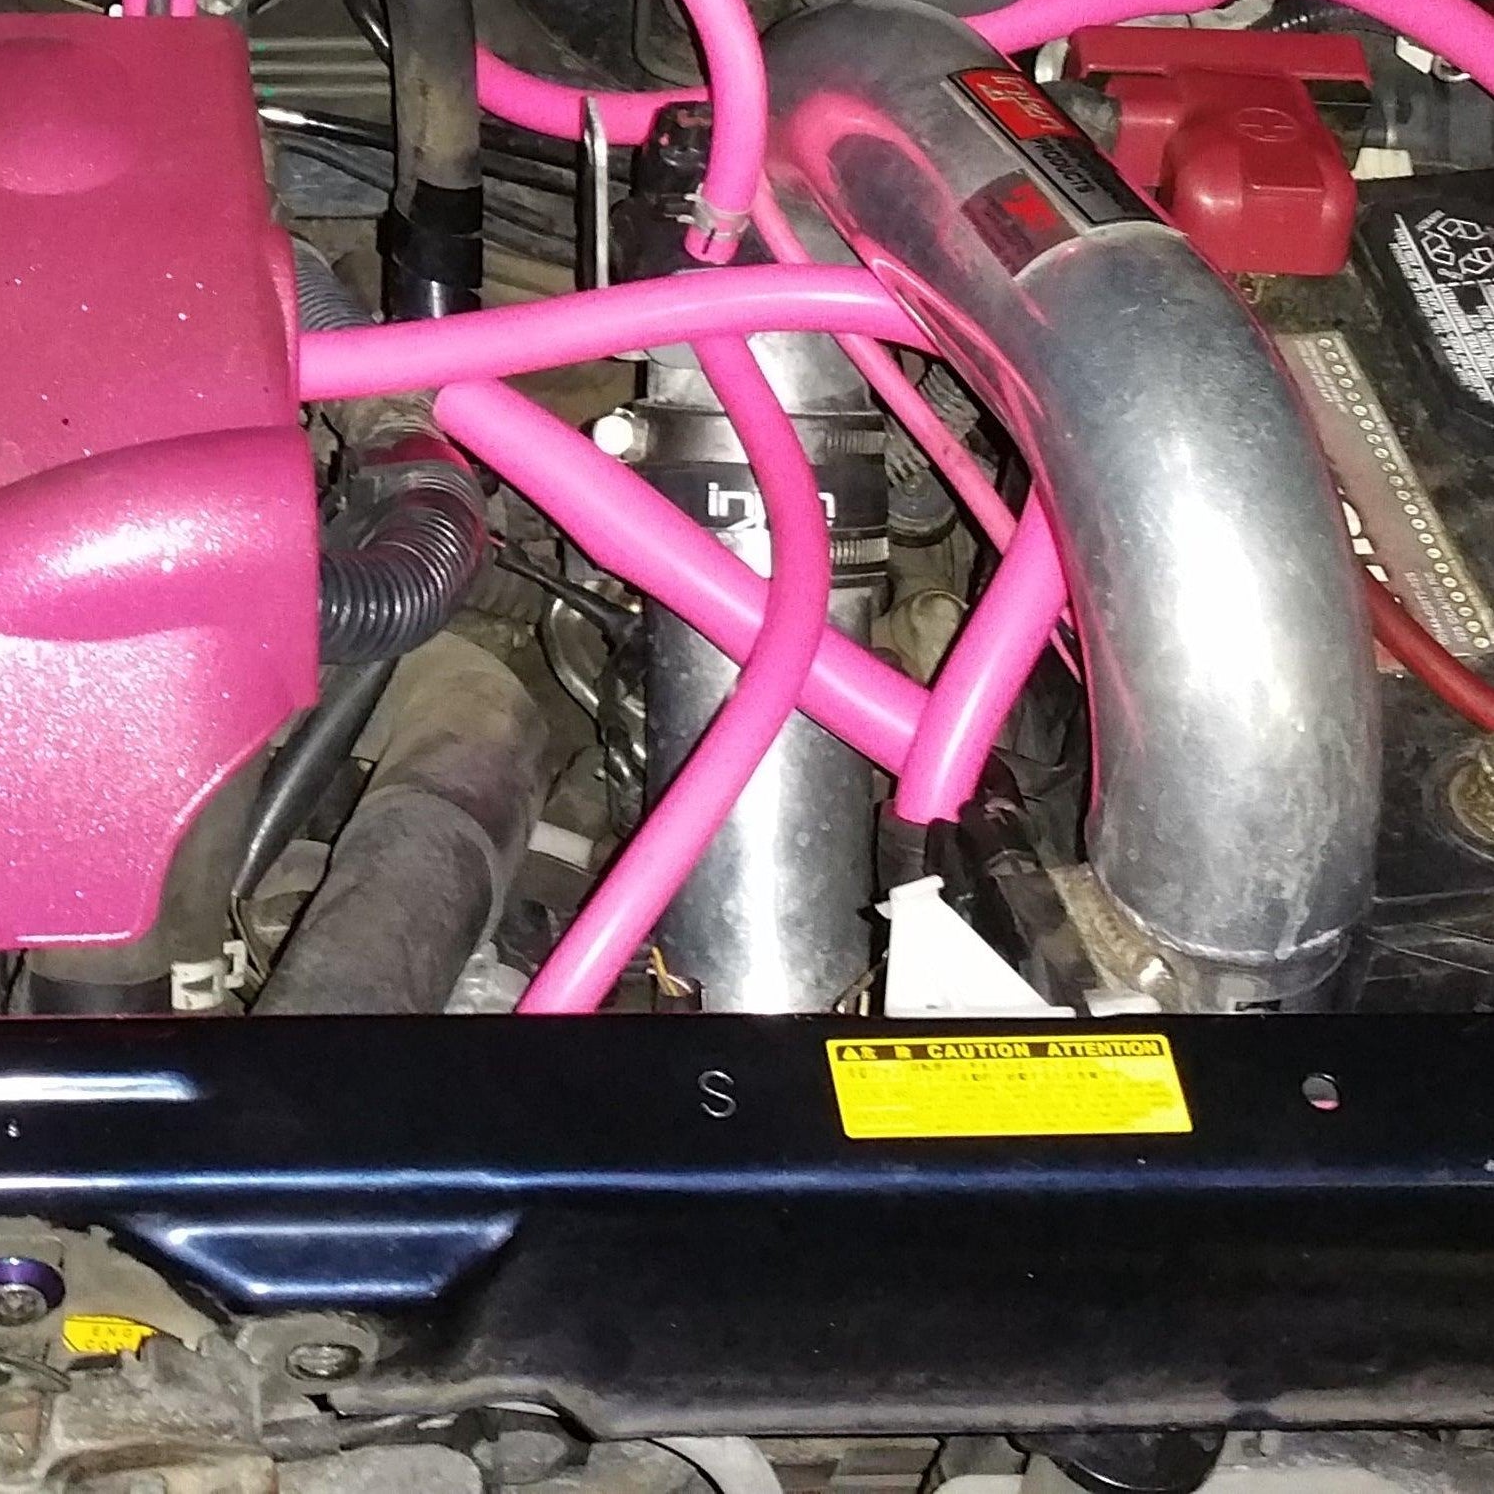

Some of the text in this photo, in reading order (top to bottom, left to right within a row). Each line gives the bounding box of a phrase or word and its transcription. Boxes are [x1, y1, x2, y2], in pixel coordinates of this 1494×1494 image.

[927, 1043, 1032, 1059] CAUTION
[1047, 1040, 1161, 1057] ATTENTION
[697, 1070, 737, 1117] S
